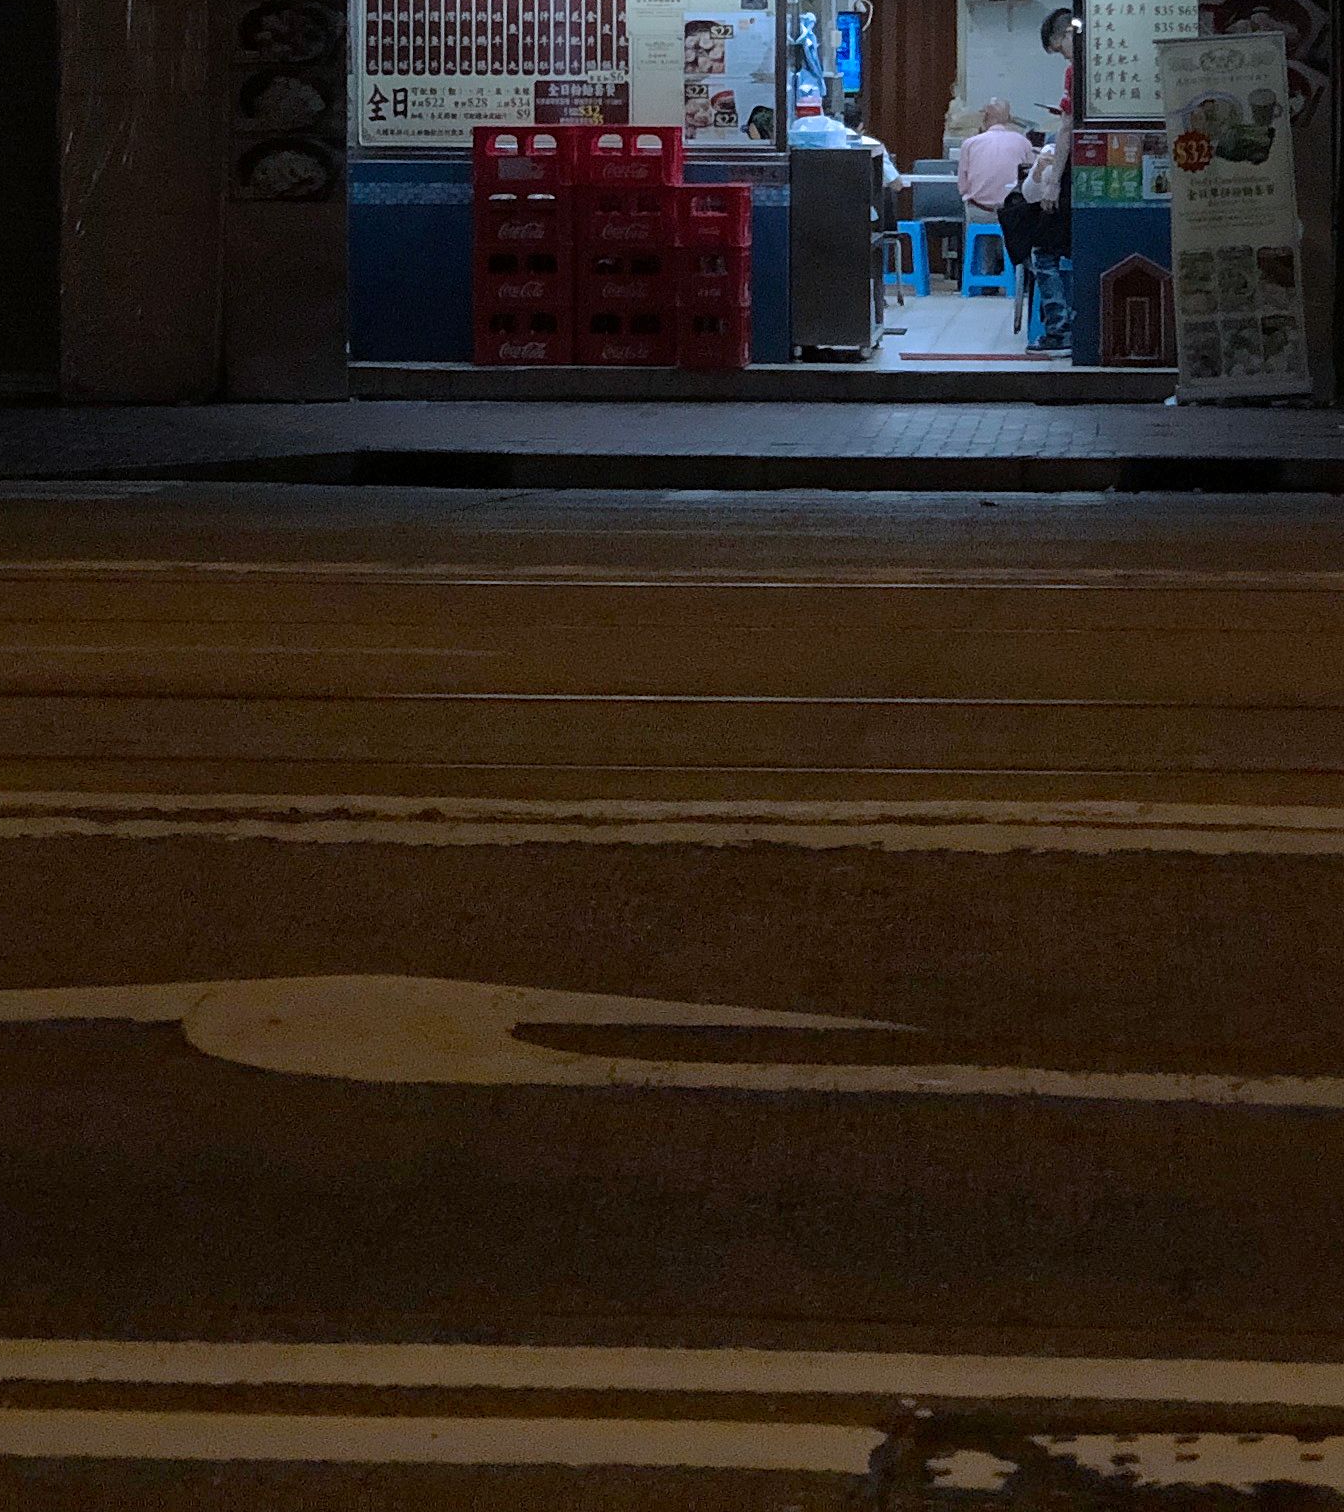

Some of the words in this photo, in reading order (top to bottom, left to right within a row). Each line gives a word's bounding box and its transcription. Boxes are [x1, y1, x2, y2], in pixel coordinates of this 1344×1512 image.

[1154, 5, 1174, 17] $35
[1154, 22, 1174, 34] $35
[366, 84, 408, 121] 全日
[1176, 142, 1212, 165] $32
